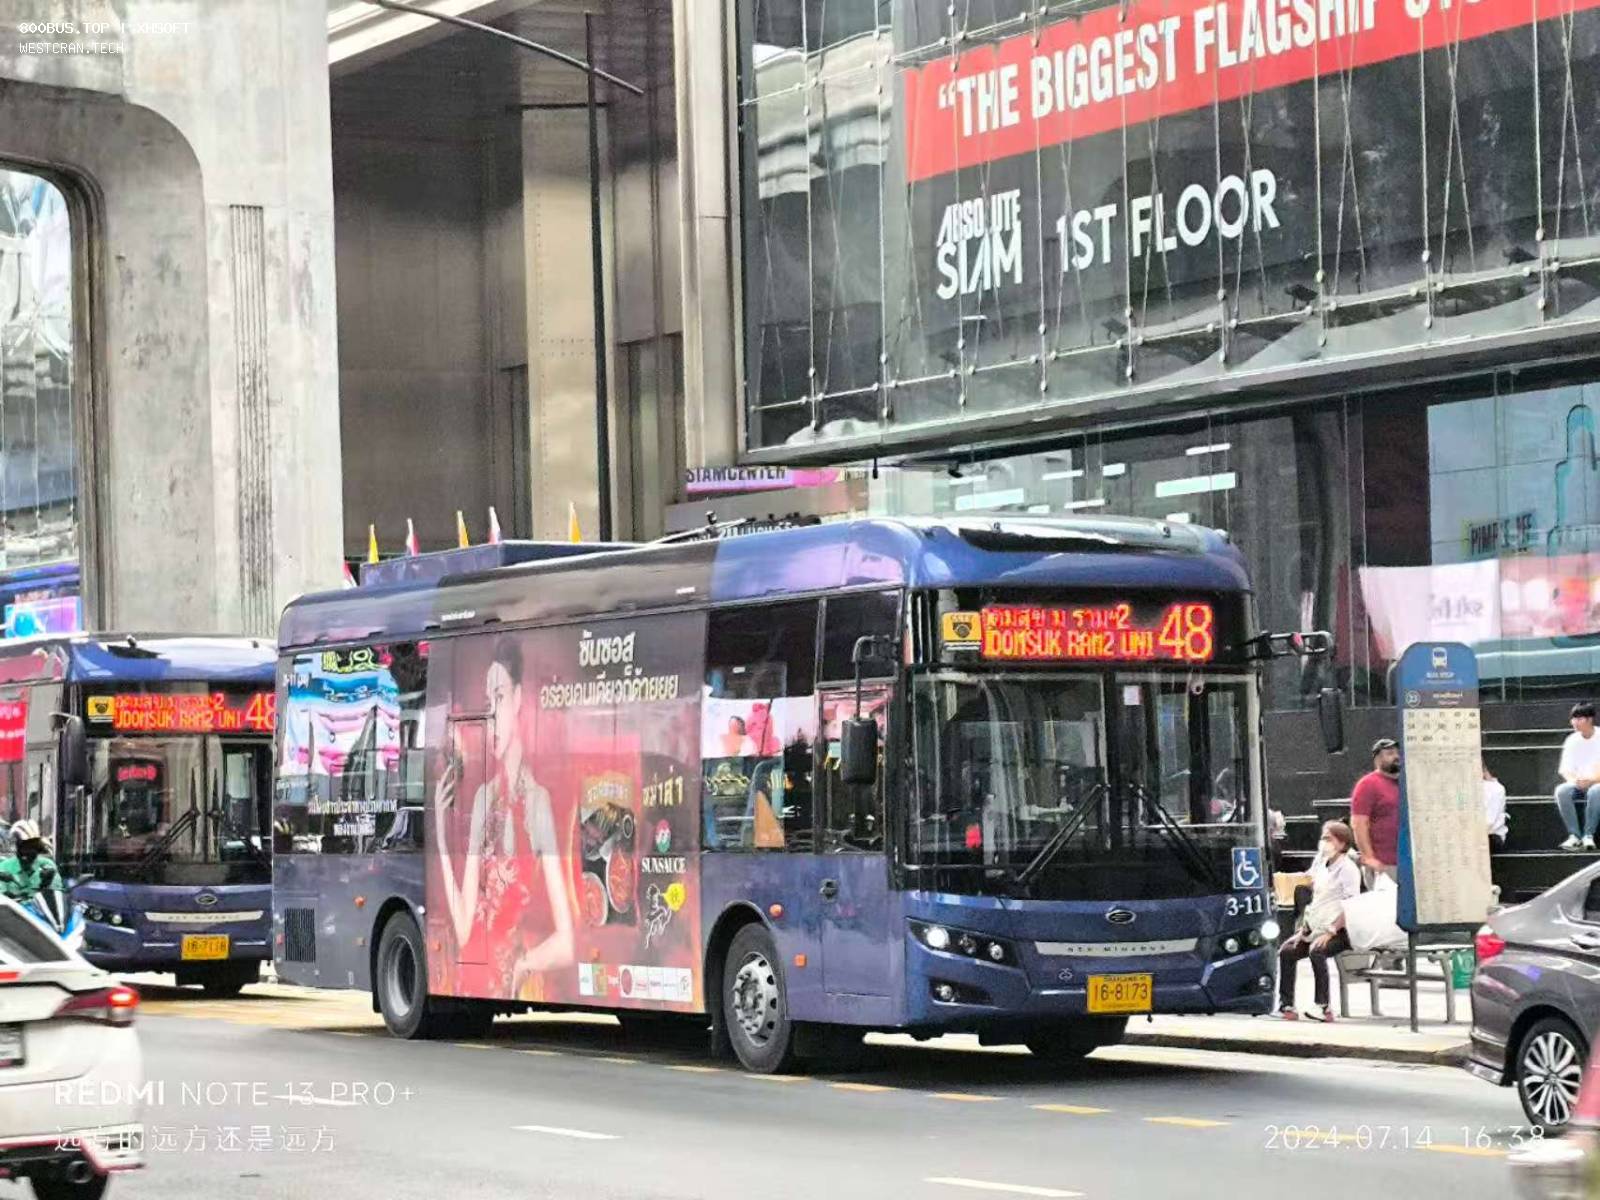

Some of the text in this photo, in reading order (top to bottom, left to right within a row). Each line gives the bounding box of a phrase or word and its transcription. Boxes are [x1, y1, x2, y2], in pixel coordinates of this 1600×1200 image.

[1030, 15, 1181, 120] BIGGEST
[1056, 168, 1282, 273] 1ST FLOOR
[936, 227, 1023, 300] SIAM
[1158, 604, 1213, 659] 48
[641, 856, 687, 873] SUNSAUCE
[1226, 894, 1264, 917] 3-11
[1094, 982, 1148, 1001] 16-8173
